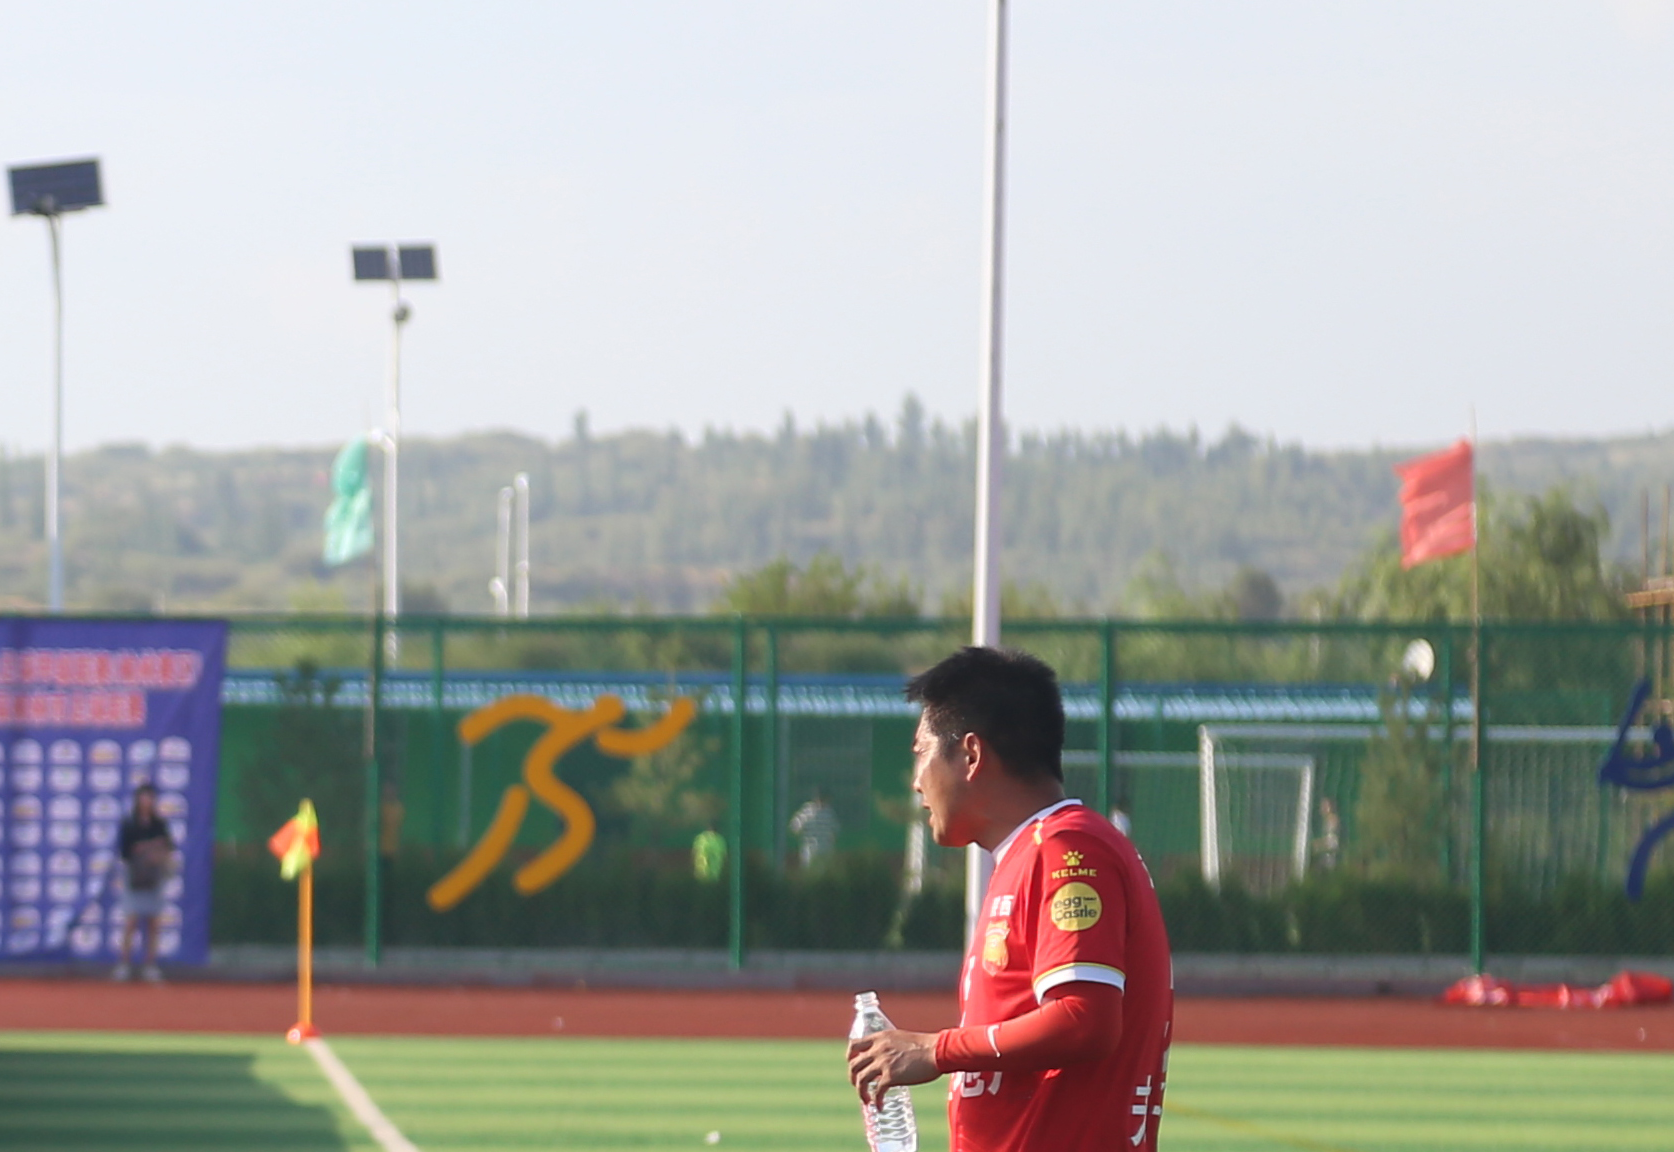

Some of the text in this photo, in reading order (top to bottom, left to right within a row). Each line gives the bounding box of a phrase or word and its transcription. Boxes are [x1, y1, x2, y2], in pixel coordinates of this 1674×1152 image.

[1051, 868, 1097, 879] KELME
[1054, 897, 1082, 910] egg
[1055, 905, 1097, 922] Castle
